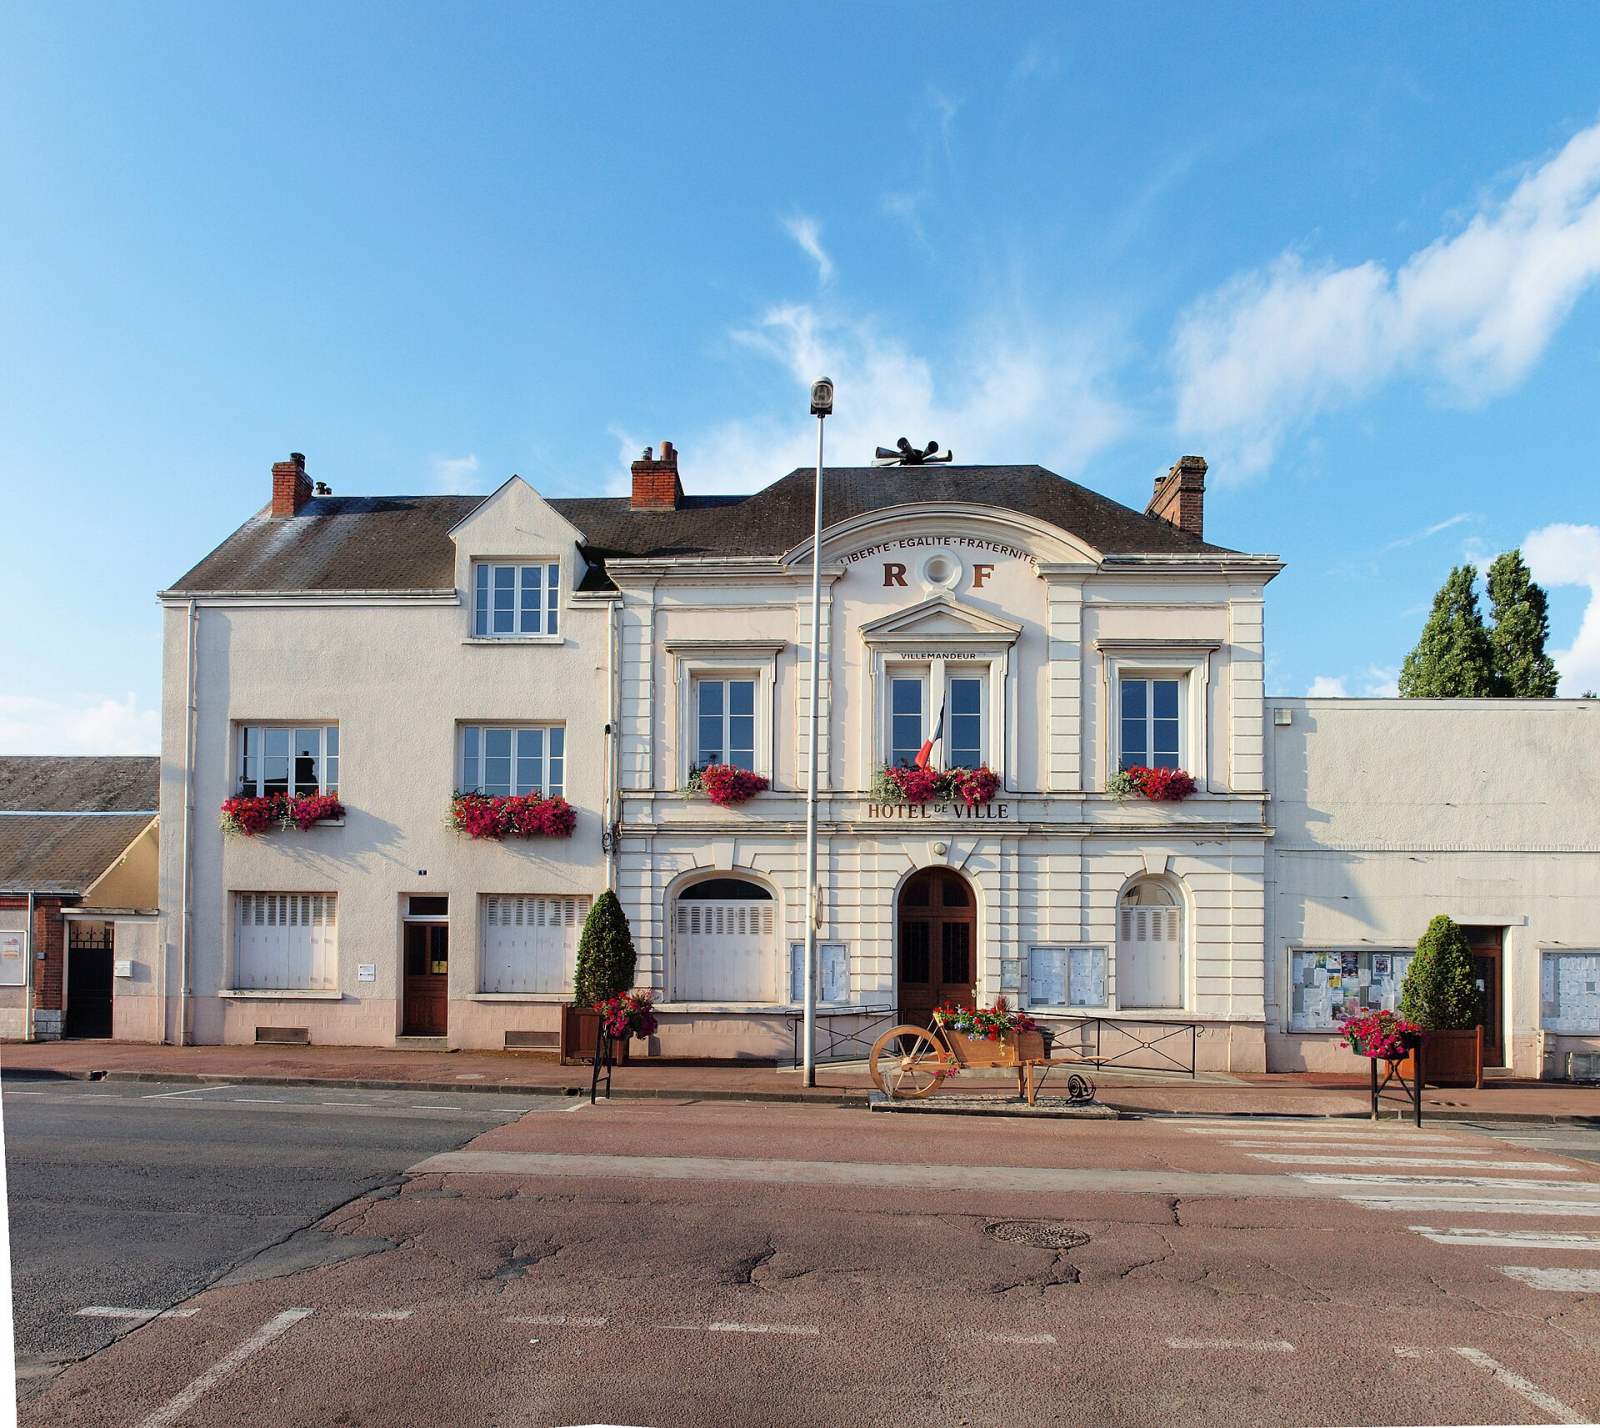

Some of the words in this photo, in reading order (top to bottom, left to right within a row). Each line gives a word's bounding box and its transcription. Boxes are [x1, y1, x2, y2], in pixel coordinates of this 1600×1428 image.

[899, 537, 951, 549] EGALITE
[959, 538, 1038, 567] FRATERNITE
[882, 563, 909, 587] R
[972, 564, 995, 588] F
[868, 803, 932, 819] HOTEL
[934, 803, 949, 813] DE
[953, 803, 1009, 819] VILLE
